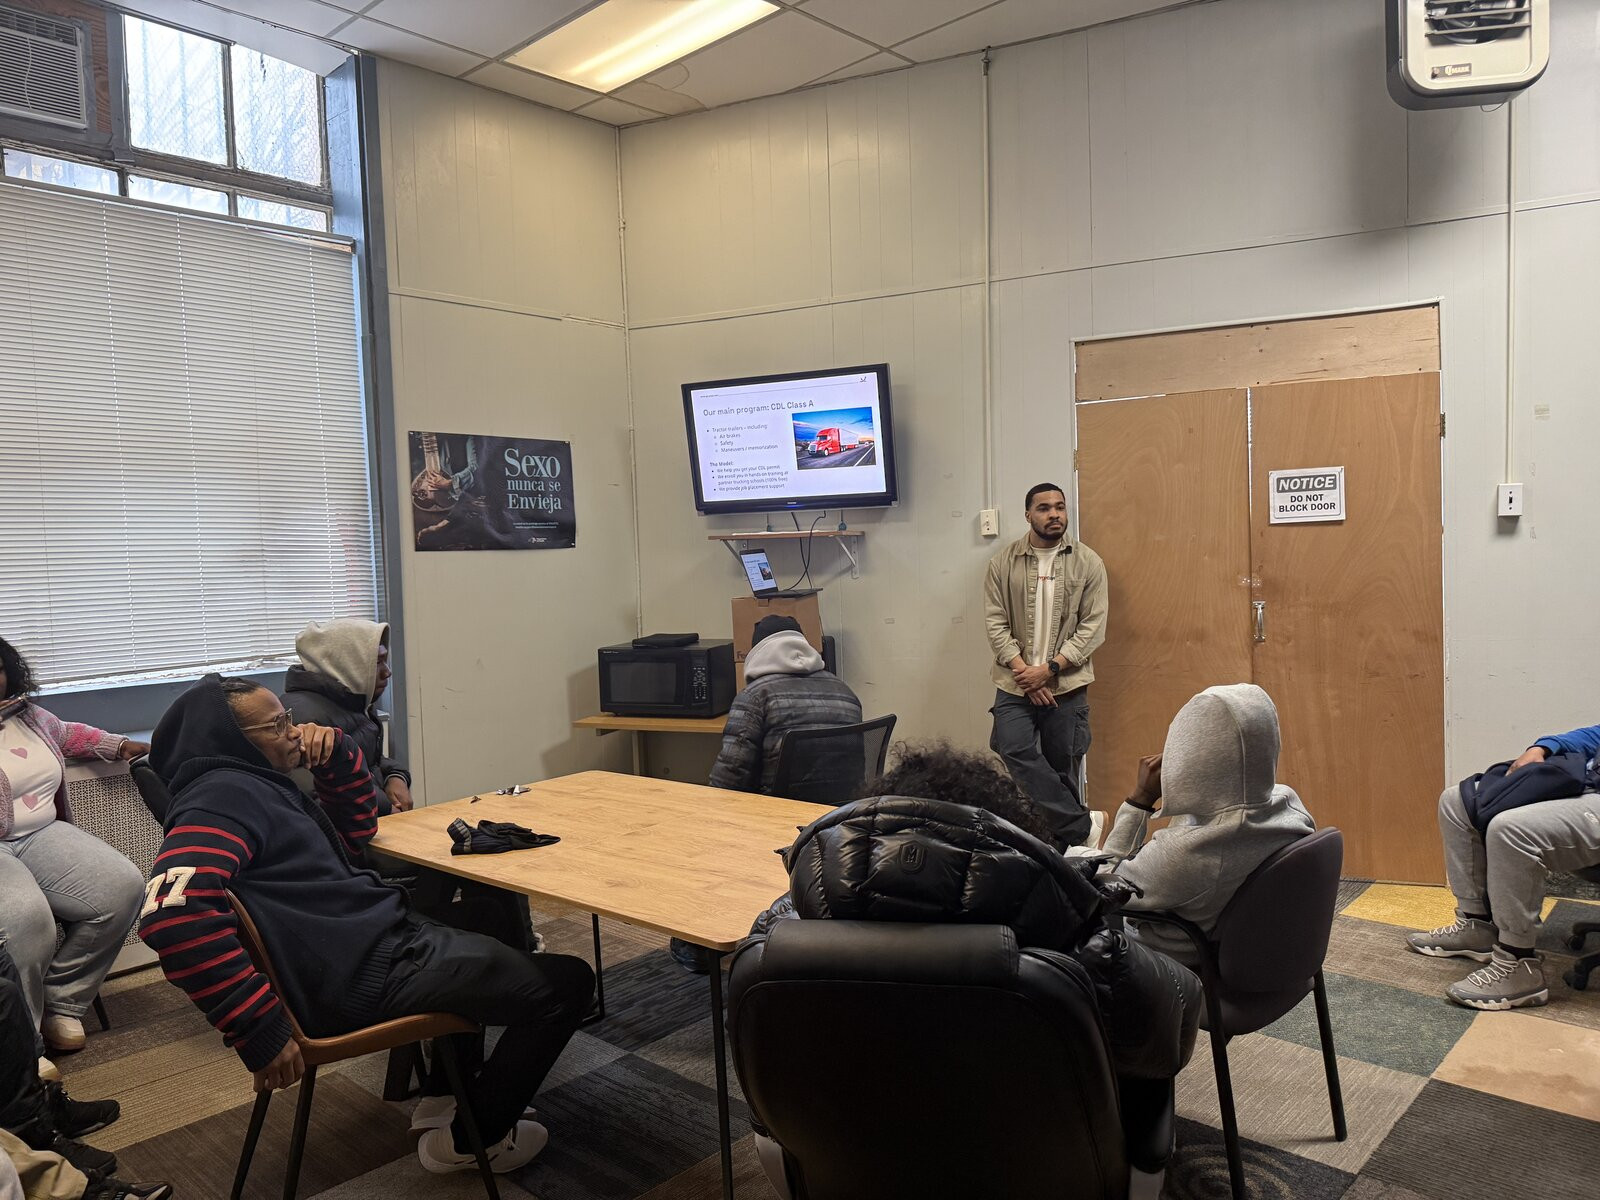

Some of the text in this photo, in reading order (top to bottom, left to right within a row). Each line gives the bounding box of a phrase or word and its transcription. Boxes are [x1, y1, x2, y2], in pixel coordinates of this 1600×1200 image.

[736, 405, 769, 415] program:
[504, 448, 561, 478] Sexo
[507, 480, 561, 491] nunca se
[1279, 476, 1335, 490] NOTICE
[507, 494, 562, 513] Envieja
[1279, 502, 1336, 512] BLOCK DOOR
